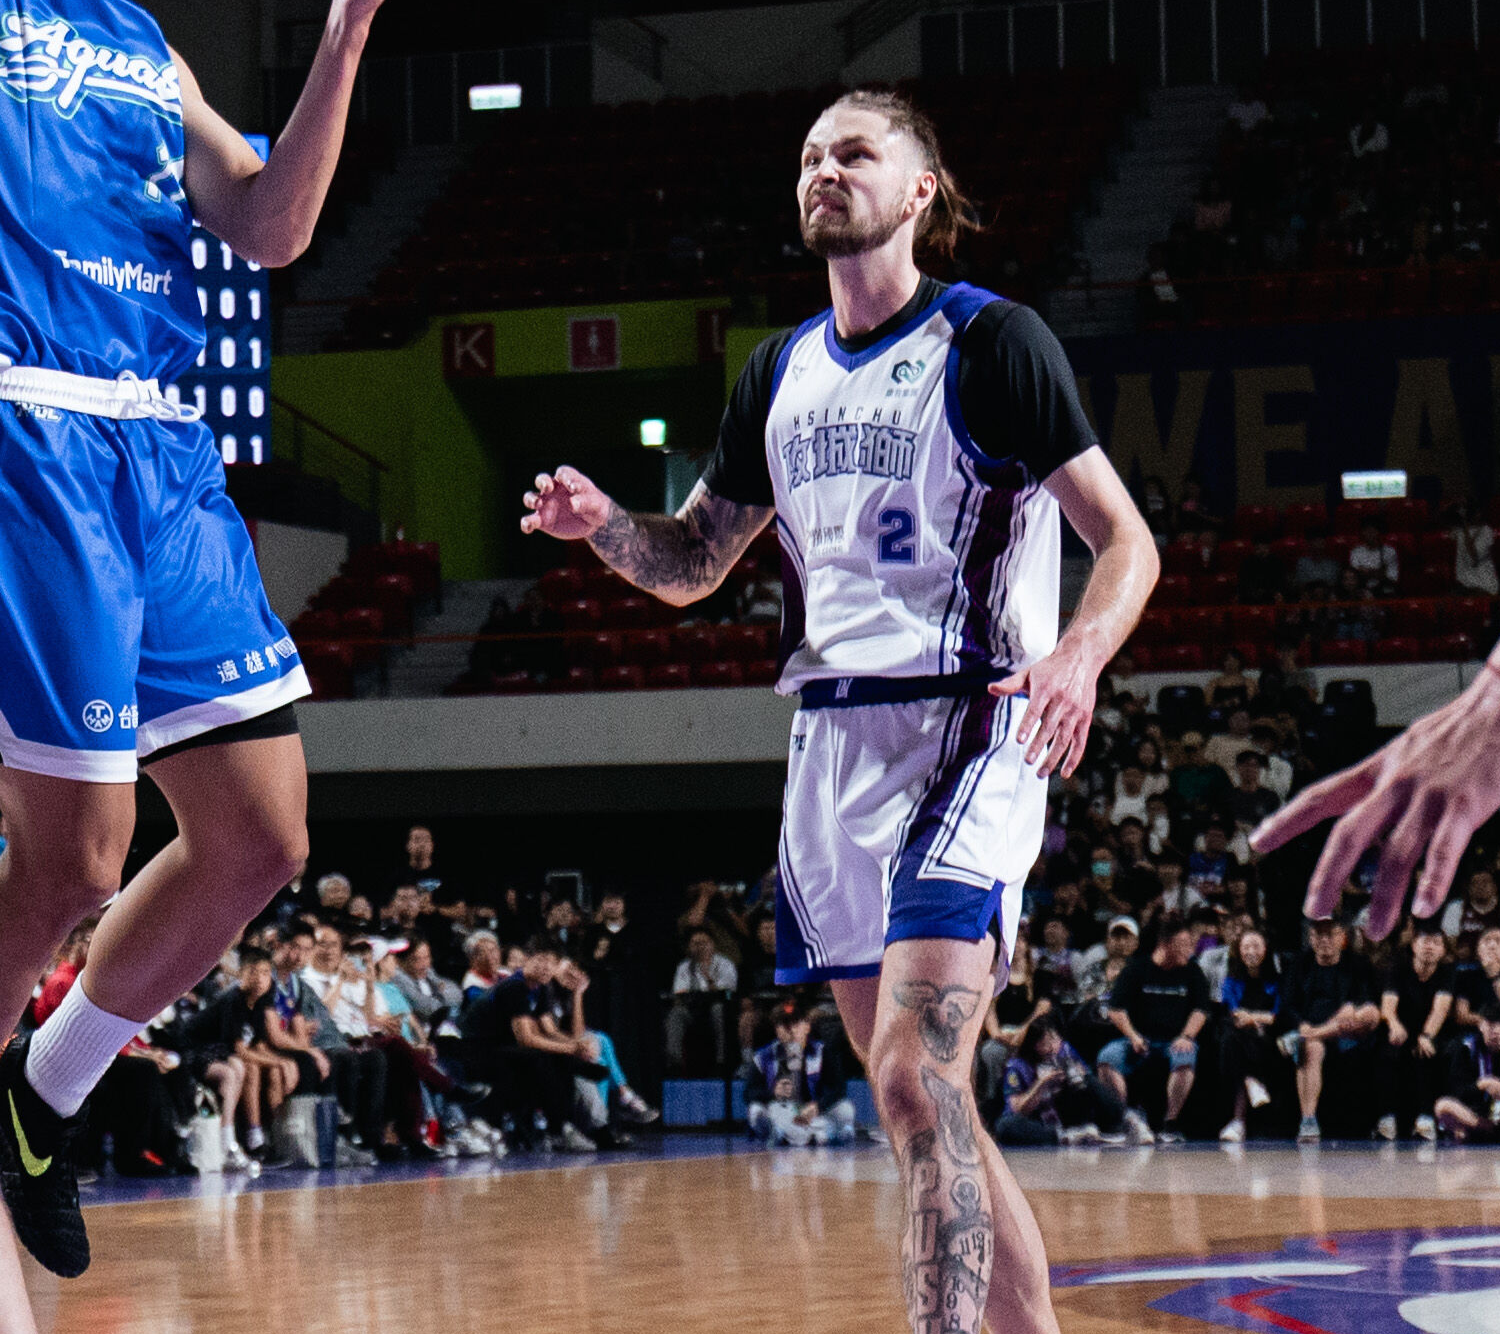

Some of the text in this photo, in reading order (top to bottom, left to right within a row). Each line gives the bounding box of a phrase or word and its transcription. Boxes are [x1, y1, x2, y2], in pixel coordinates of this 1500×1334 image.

[2, 11, 181, 113] Aquas
[219, 287, 236, 320] 0
[248, 288, 262, 321] 1
[220, 336, 236, 369] 0
[248, 337, 262, 369] 1
[453, 329, 487, 370] K
[220, 385, 237, 418] 0
[248, 385, 265, 418] 0
[793, 406, 903, 431] HSINCHU
[782, 423, 918, 492] 攻城獅
[876, 506, 917, 565] 2
